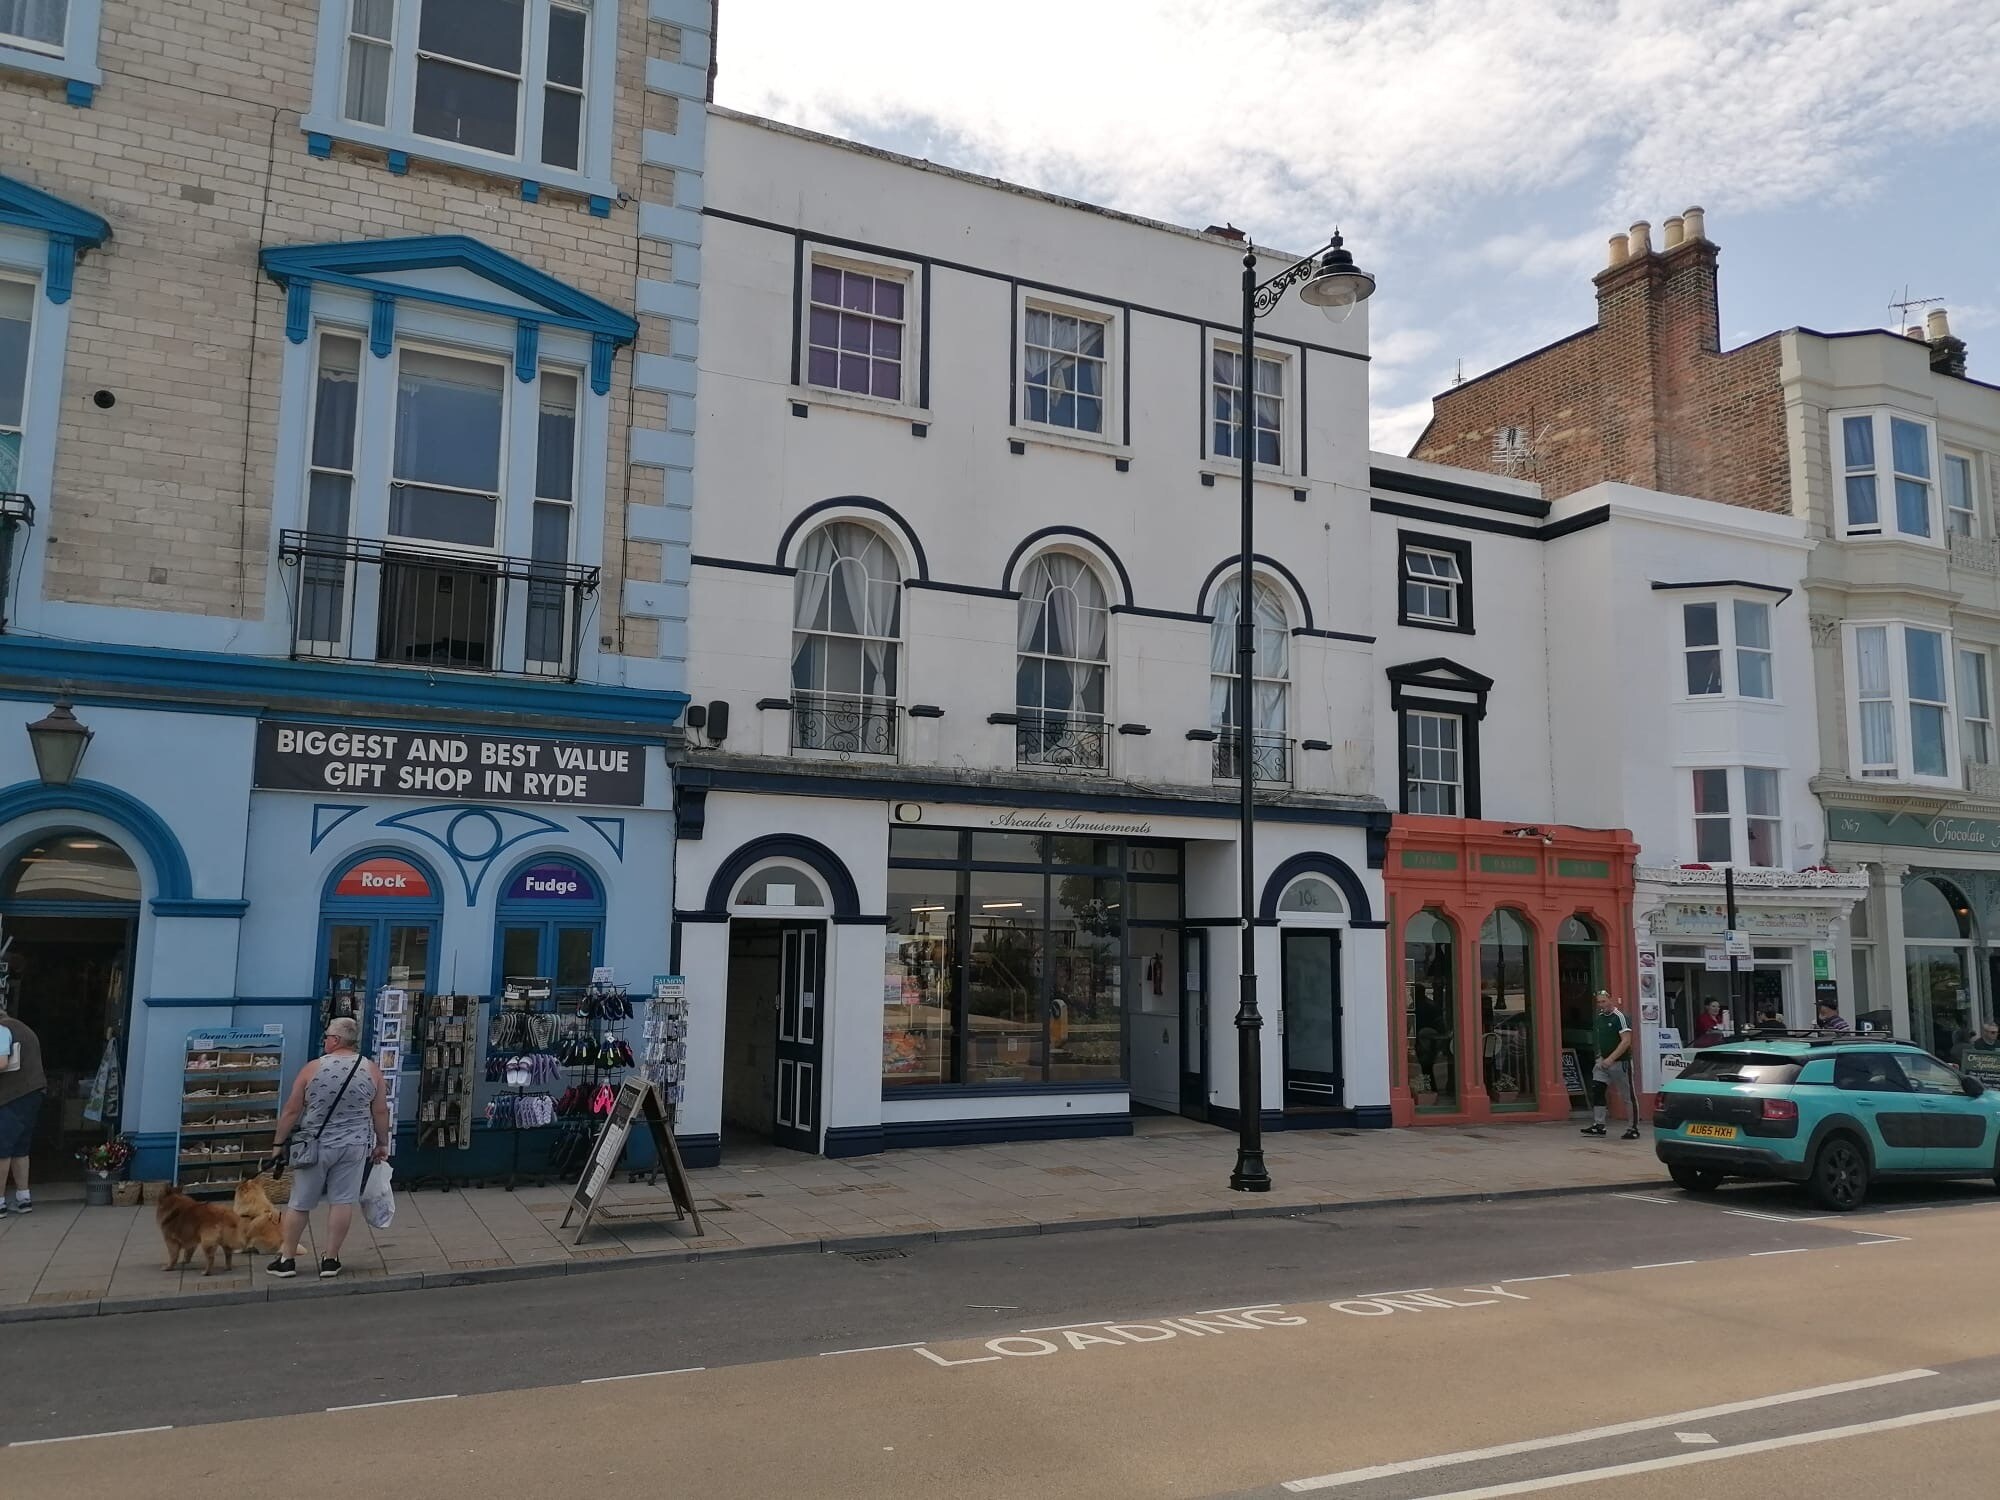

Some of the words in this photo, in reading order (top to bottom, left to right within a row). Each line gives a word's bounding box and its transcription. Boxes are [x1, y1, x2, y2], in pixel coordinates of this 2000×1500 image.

[277, 729, 398, 760] BIGGEST
[406, 738, 468, 763] AND
[480, 742, 541, 767] BEST
[553, 746, 629, 773] VALUE
[324, 761, 382, 787] GIFT
[398, 765, 473, 792] SHOP
[484, 770, 512, 794] IN
[523, 772, 587, 797] RYDE
[990, 811, 1053, 829] Arcadia
[1056, 815, 1151, 835] Amusements
[1933, 819, 1985, 843] Chocolate
[1130, 851, 1155, 871] 10
[361, 871, 408, 889] Rock
[525, 876, 578, 895] Fudge
[1569, 920, 1578, 938] 9
[1690, 1124, 1713, 1136] AU65
[1714, 1126, 1733, 1137] HXH
[913, 1309, 1307, 1366] LOADING
[1329, 1285, 1531, 1316] ONLY
